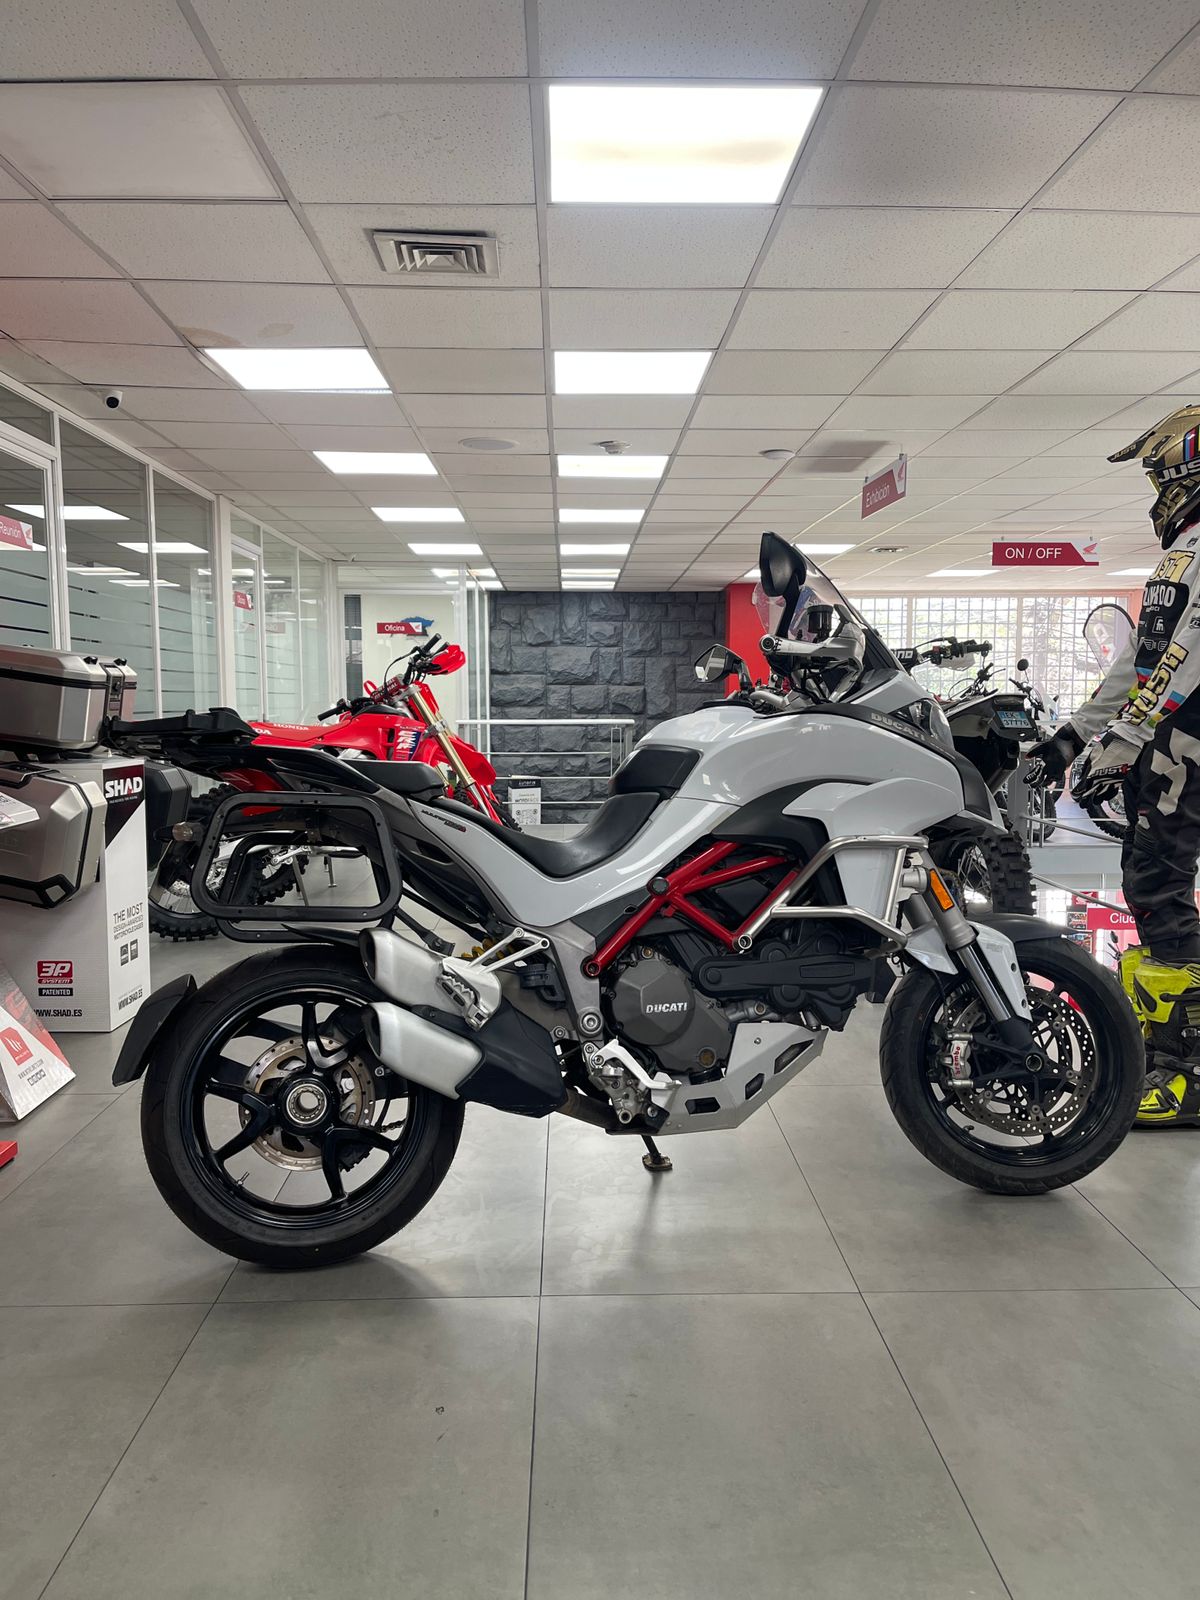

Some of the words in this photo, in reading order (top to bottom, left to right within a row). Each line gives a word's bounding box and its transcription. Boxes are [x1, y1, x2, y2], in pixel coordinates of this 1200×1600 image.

[1005, 547, 1025, 559] ON
[1027, 547, 1034, 559] /
[1035, 547, 1063, 559] OFF
[384, 624, 406, 632] Oficina
[1127, 641, 1189, 727] JUST1
[272, 723, 309, 731] HONDA
[871, 712, 926, 741] DUCATI
[104, 776, 143, 799] SHAD
[113, 909, 126, 925] THE
[126, 902, 143, 919] MOST
[646, 1002, 688, 1014] DUCATI
[953, 1046, 961, 1076] brembo
